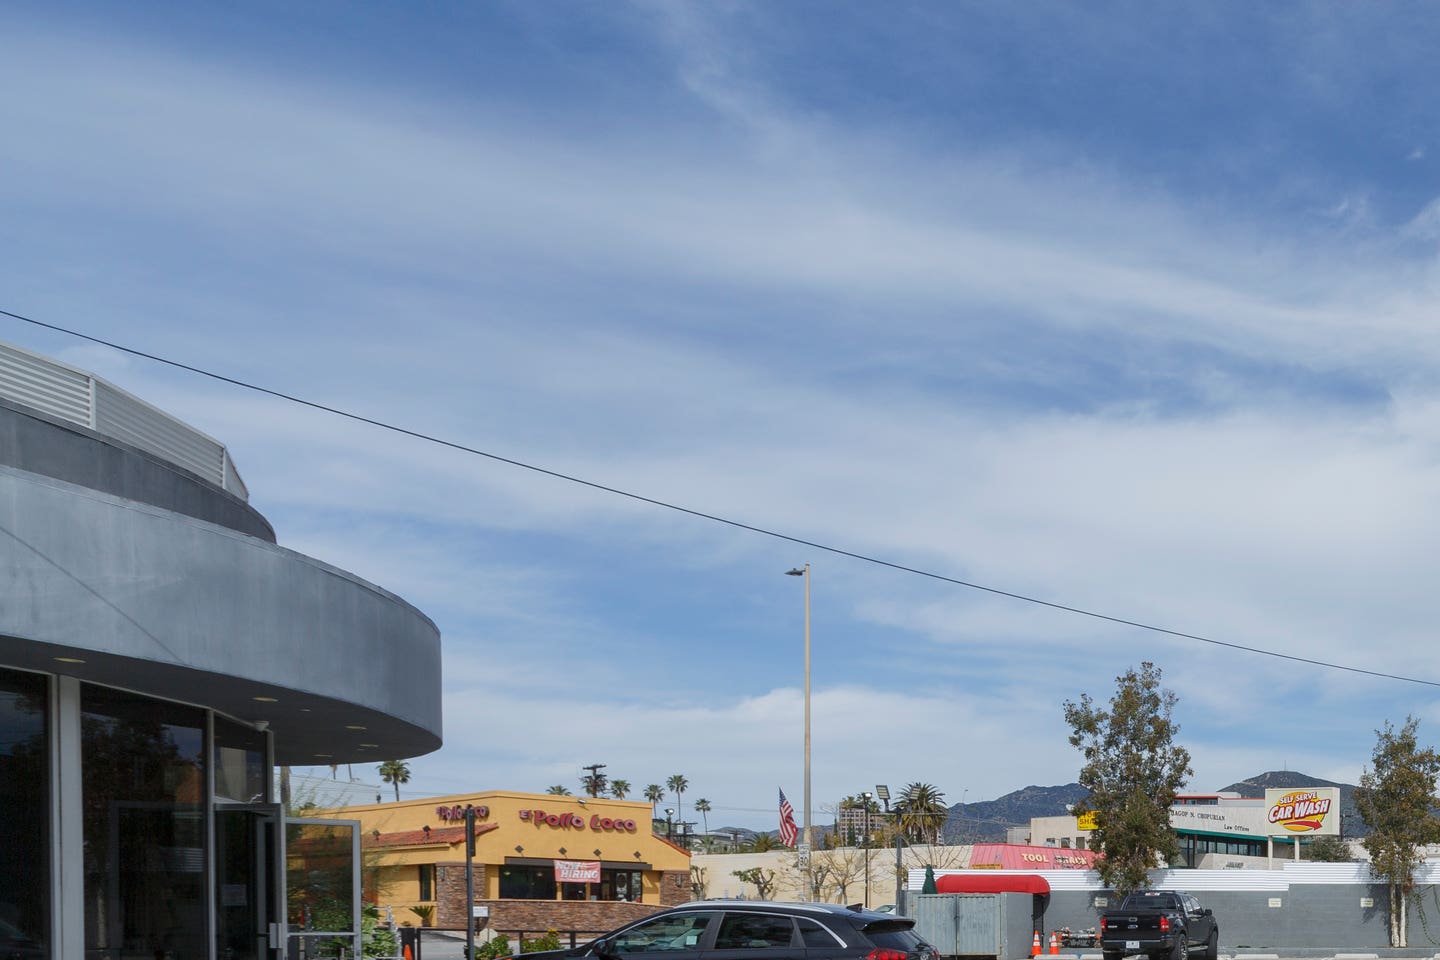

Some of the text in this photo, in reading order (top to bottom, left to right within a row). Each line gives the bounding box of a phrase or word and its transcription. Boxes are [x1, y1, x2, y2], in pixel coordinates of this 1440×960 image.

[1280, 791, 1317, 804] SELF SERVE
[1268, 799, 1331, 823] CAR WASH
[534, 809, 585, 829] Pollo
[590, 814, 637, 832] Loco
[1021, 853, 1049, 863] TOOL
[560, 870, 598, 879] HIRING
